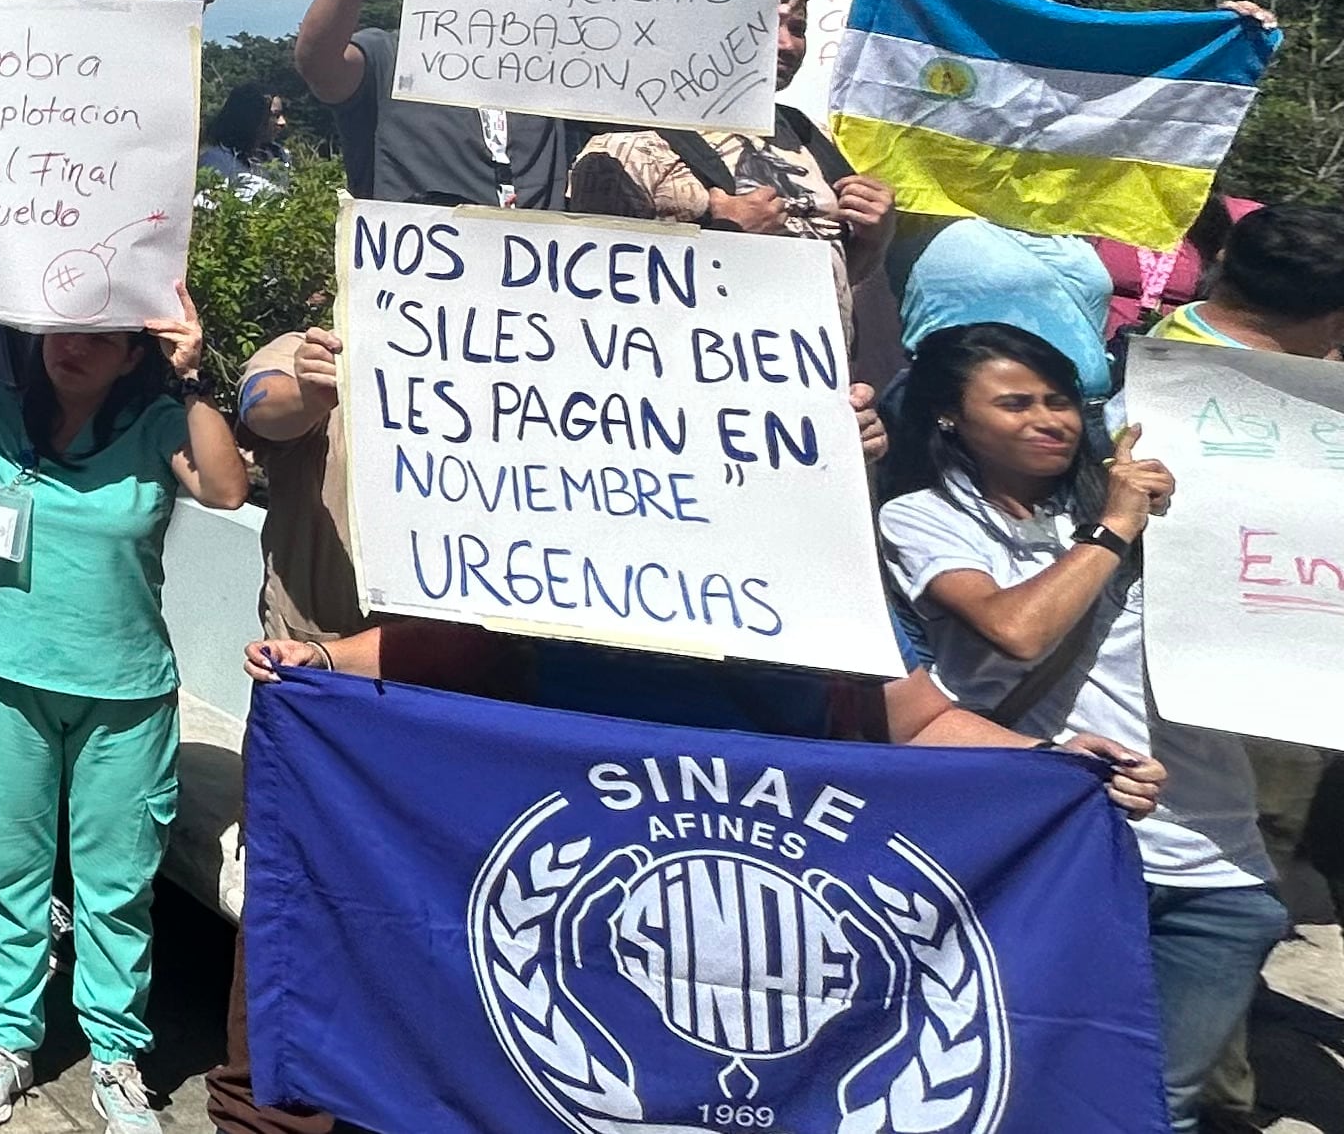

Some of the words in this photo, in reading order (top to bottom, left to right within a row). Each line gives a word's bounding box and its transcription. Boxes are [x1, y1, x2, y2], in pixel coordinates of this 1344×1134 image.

[411, 9, 621, 51] TRABAJO
[422, 50, 630, 91] VOCACIÓN
[635, 11, 769, 117] PAGUEN
[27, 151, 118, 197] Final
[353, 215, 465, 281] NOS
[501, 233, 729, 308] DICEN:
[580, 316, 664, 378] VA
[690, 326, 840, 391] BIEN
[374, 368, 473, 443] LES
[491, 381, 688, 457] PAGAN
[717, 407, 820, 470] EN
[410, 529, 783, 636] URGENCIAS
[587, 753, 868, 846] SINAE
[646, 812, 809, 861] AFINES
[695, 1101, 776, 1131] 1969
